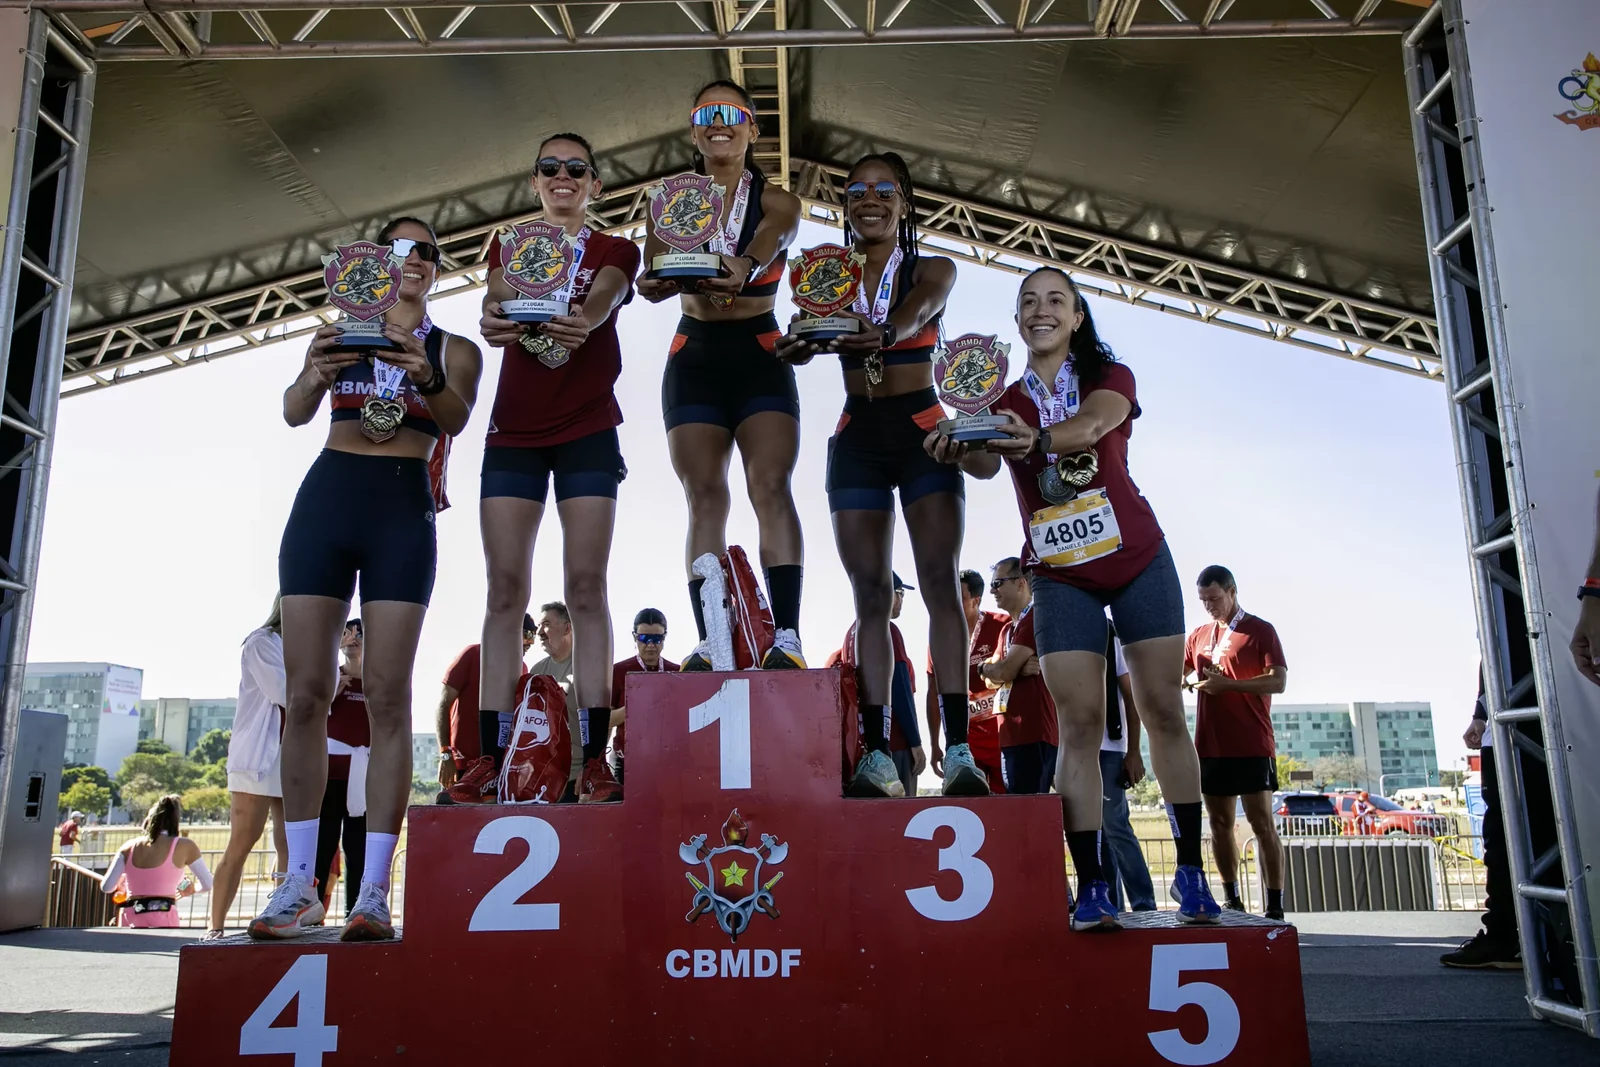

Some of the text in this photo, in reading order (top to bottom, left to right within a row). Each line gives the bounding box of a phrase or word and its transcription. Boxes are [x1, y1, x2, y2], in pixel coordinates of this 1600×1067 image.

[674, 178, 700, 186] CBMDF
[524, 226, 552, 234] CBMDF
[348, 246, 378, 254] CBMDF
[813, 248, 841, 256] CBMDF
[956, 338, 984, 348] CBMDF
[334, 381, 406, 395] CBMF
[1044, 513, 1104, 546] 4805
[1056, 537, 1099, 553] DANIELE SILVA
[1074, 550, 1087, 560] 5K
[689, 678, 751, 789] 1
[904, 806, 994, 922] 3
[468, 816, 560, 932] 2
[665, 948, 802, 978] CBMDF
[239, 954, 338, 1067] 4
[1147, 942, 1240, 1066] 5
